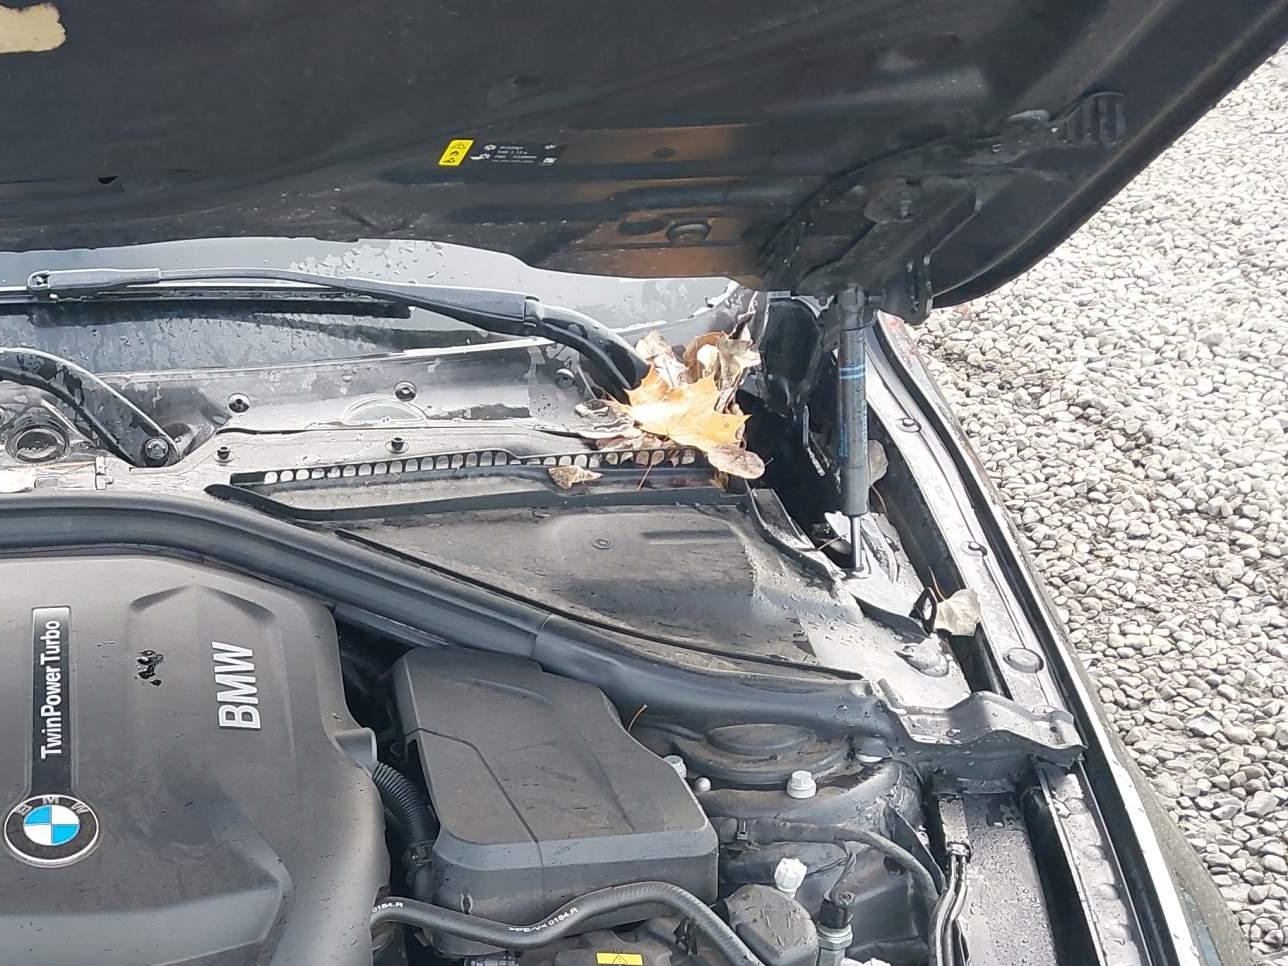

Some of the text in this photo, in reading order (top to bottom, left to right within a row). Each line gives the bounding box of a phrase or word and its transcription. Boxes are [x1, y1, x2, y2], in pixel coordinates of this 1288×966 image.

[40, 620, 63, 759] TwinPower Turbo
[211, 641, 261, 729] BMW
[13, 795, 89, 816] BMW
